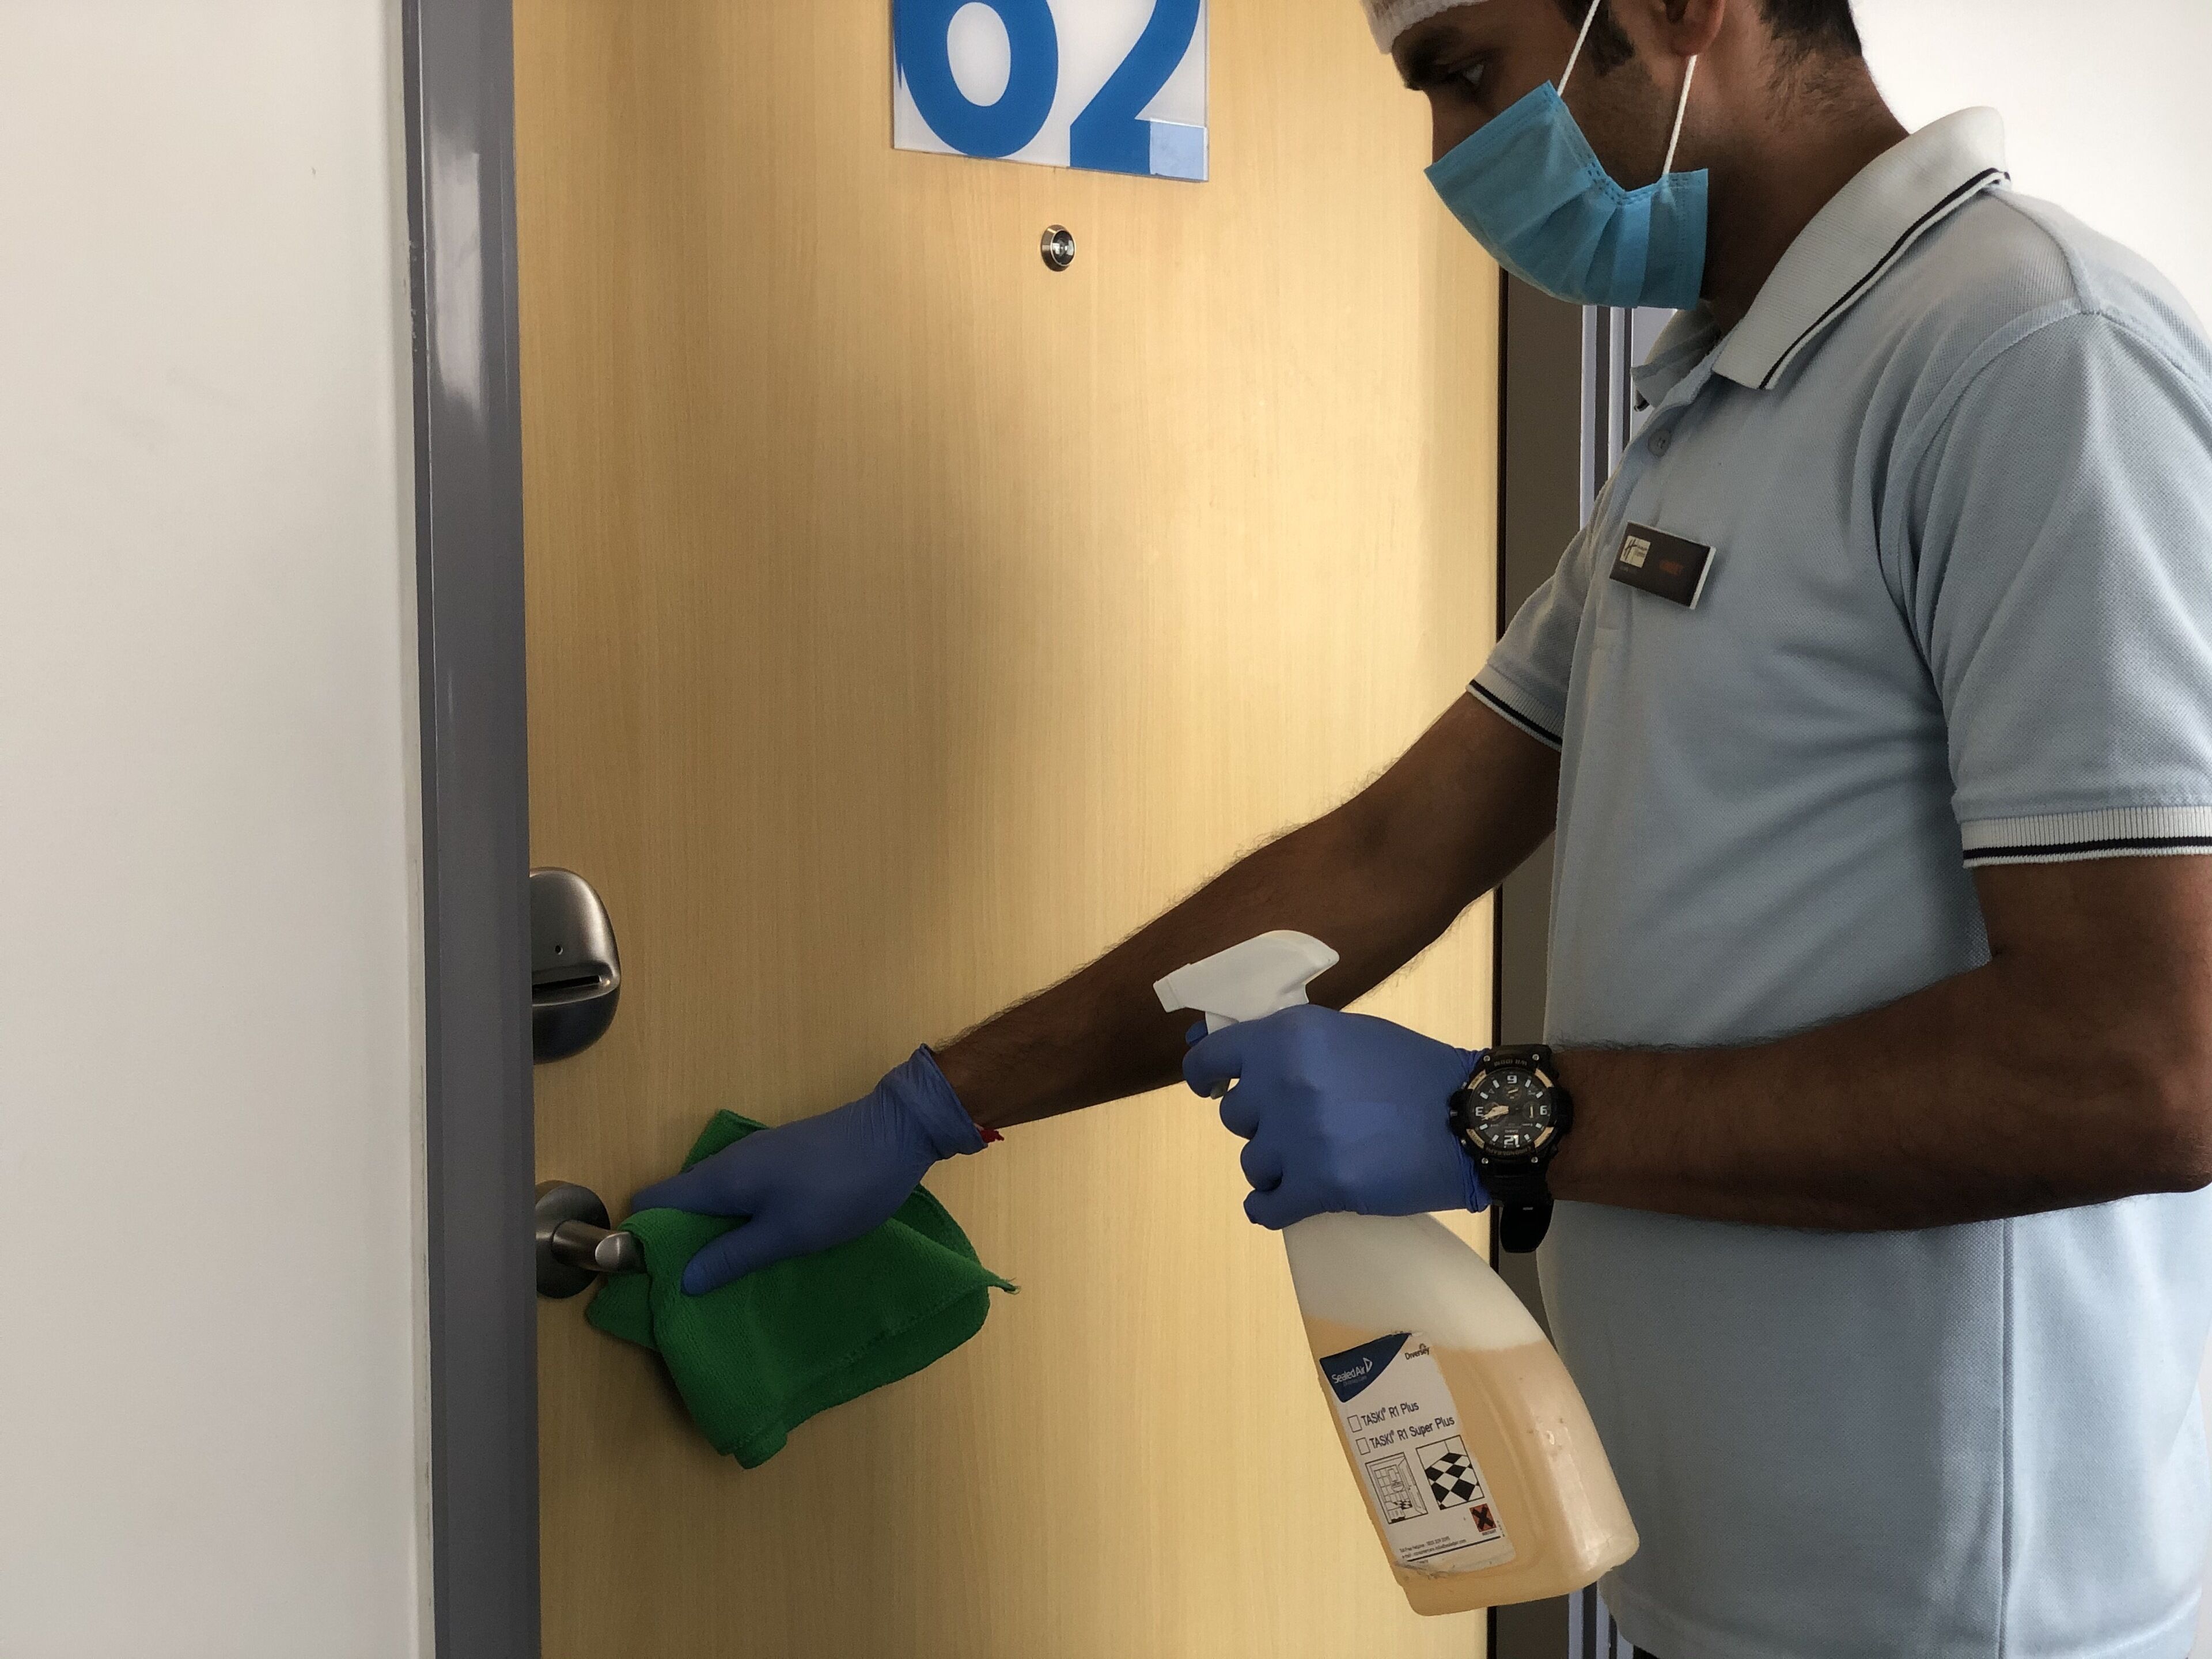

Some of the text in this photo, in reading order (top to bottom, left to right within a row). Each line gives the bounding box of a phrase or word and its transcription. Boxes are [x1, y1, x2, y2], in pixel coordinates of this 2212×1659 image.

[1507, 1075, 1517, 1084] 6
[1475, 1107, 1484, 1116] 3
[1504, 1134, 1520, 1147] 12
[1404, 1347, 1430, 1360] Diversey
[1388, 1406, 1400, 1418] R1
[1400, 1402, 1419, 1414] Plus
[1397, 1429, 1408, 1441] R1
[1409, 1423, 1433, 1437] Super
[1434, 1416, 1455, 1430] Plus
